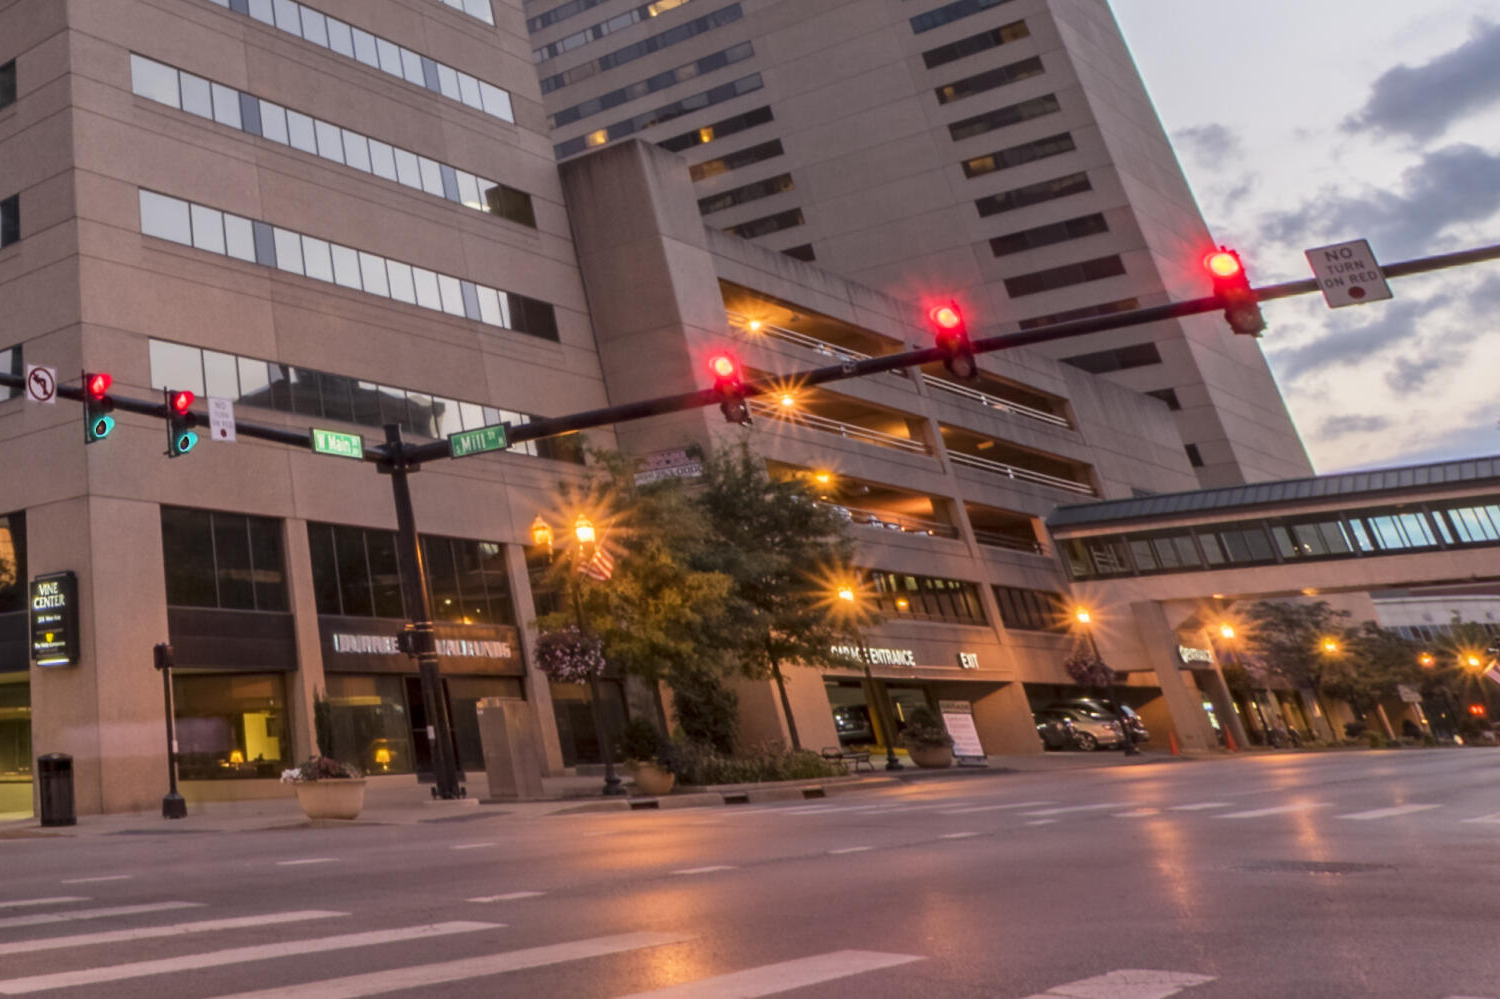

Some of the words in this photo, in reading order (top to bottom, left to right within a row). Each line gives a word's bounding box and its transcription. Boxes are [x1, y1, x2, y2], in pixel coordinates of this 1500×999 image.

[1324, 247, 1353, 262] NO
[1326, 260, 1365, 275] TURN
[1324, 277, 1345, 289] ON
[1349, 271, 1378, 285] RED
[214, 401, 228, 410] NO
[328, 434, 351, 453] Main
[461, 433, 485, 452] Mill
[38, 582, 58, 595] VINE
[33, 594, 65, 609] CENTER
[869, 648, 915, 666] ENTRANCE
[960, 652, 979, 669] EXIT
